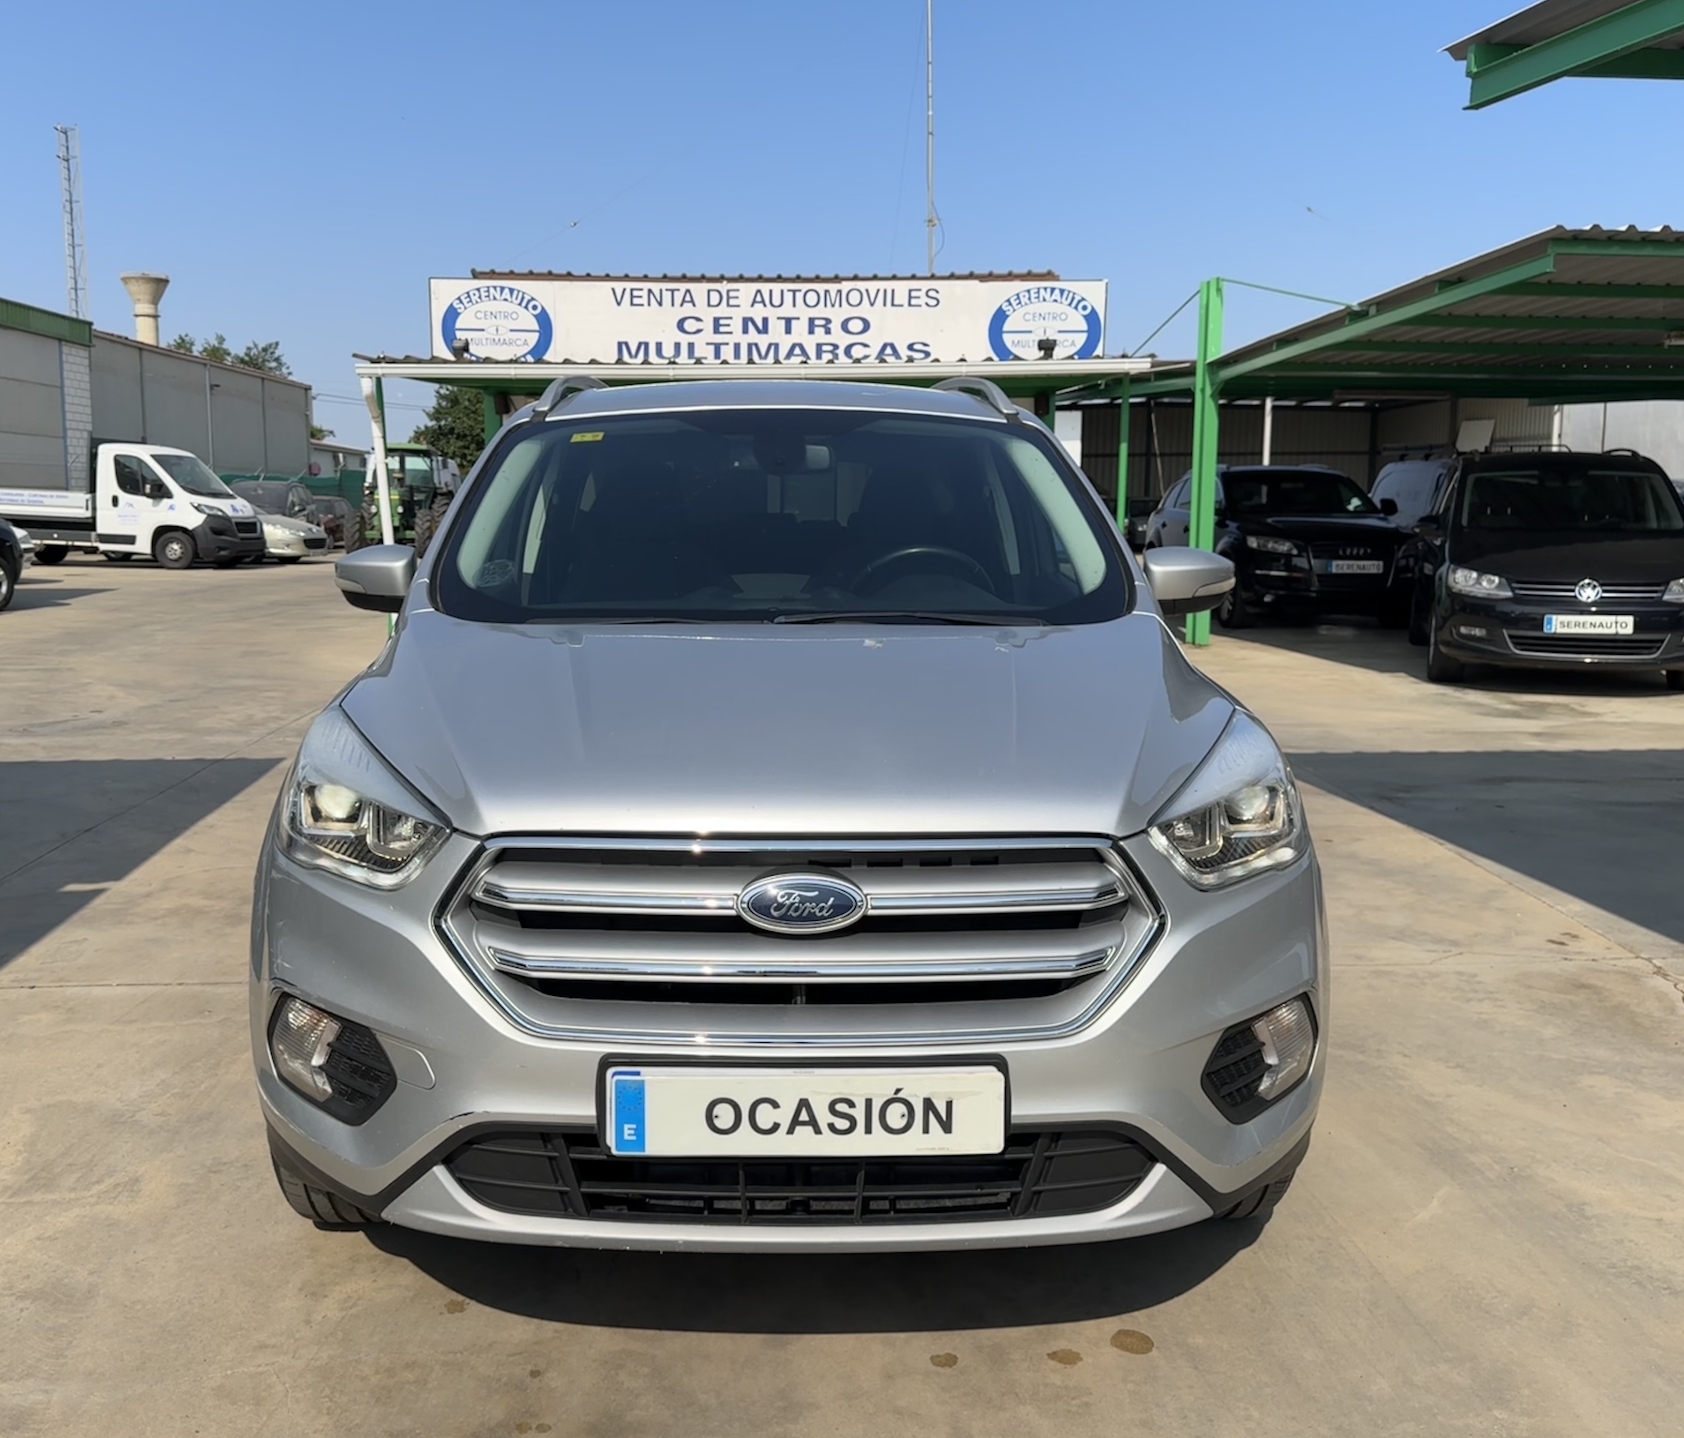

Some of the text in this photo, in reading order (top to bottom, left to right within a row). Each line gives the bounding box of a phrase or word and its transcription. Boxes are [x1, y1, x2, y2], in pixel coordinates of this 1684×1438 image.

[452, 286, 542, 315] SERENAUTO
[611, 287, 940, 309] VENTA DE AUTOMOVILES
[1001, 287, 1092, 316] SERENAUTO
[474, 310, 520, 321] CENTRO
[1022, 311, 1069, 322] CENTRO
[676, 316, 871, 335] CENTRO
[616, 341, 932, 361] MULTIMARCAS
[1011, 340, 1077, 348] MULTRCA
[1559, 620, 1628, 630] SERENAUTO
[770, 889, 835, 917] Ford
[705, 1088, 954, 1136] OCASIÓN
[623, 1124, 637, 1140] E
